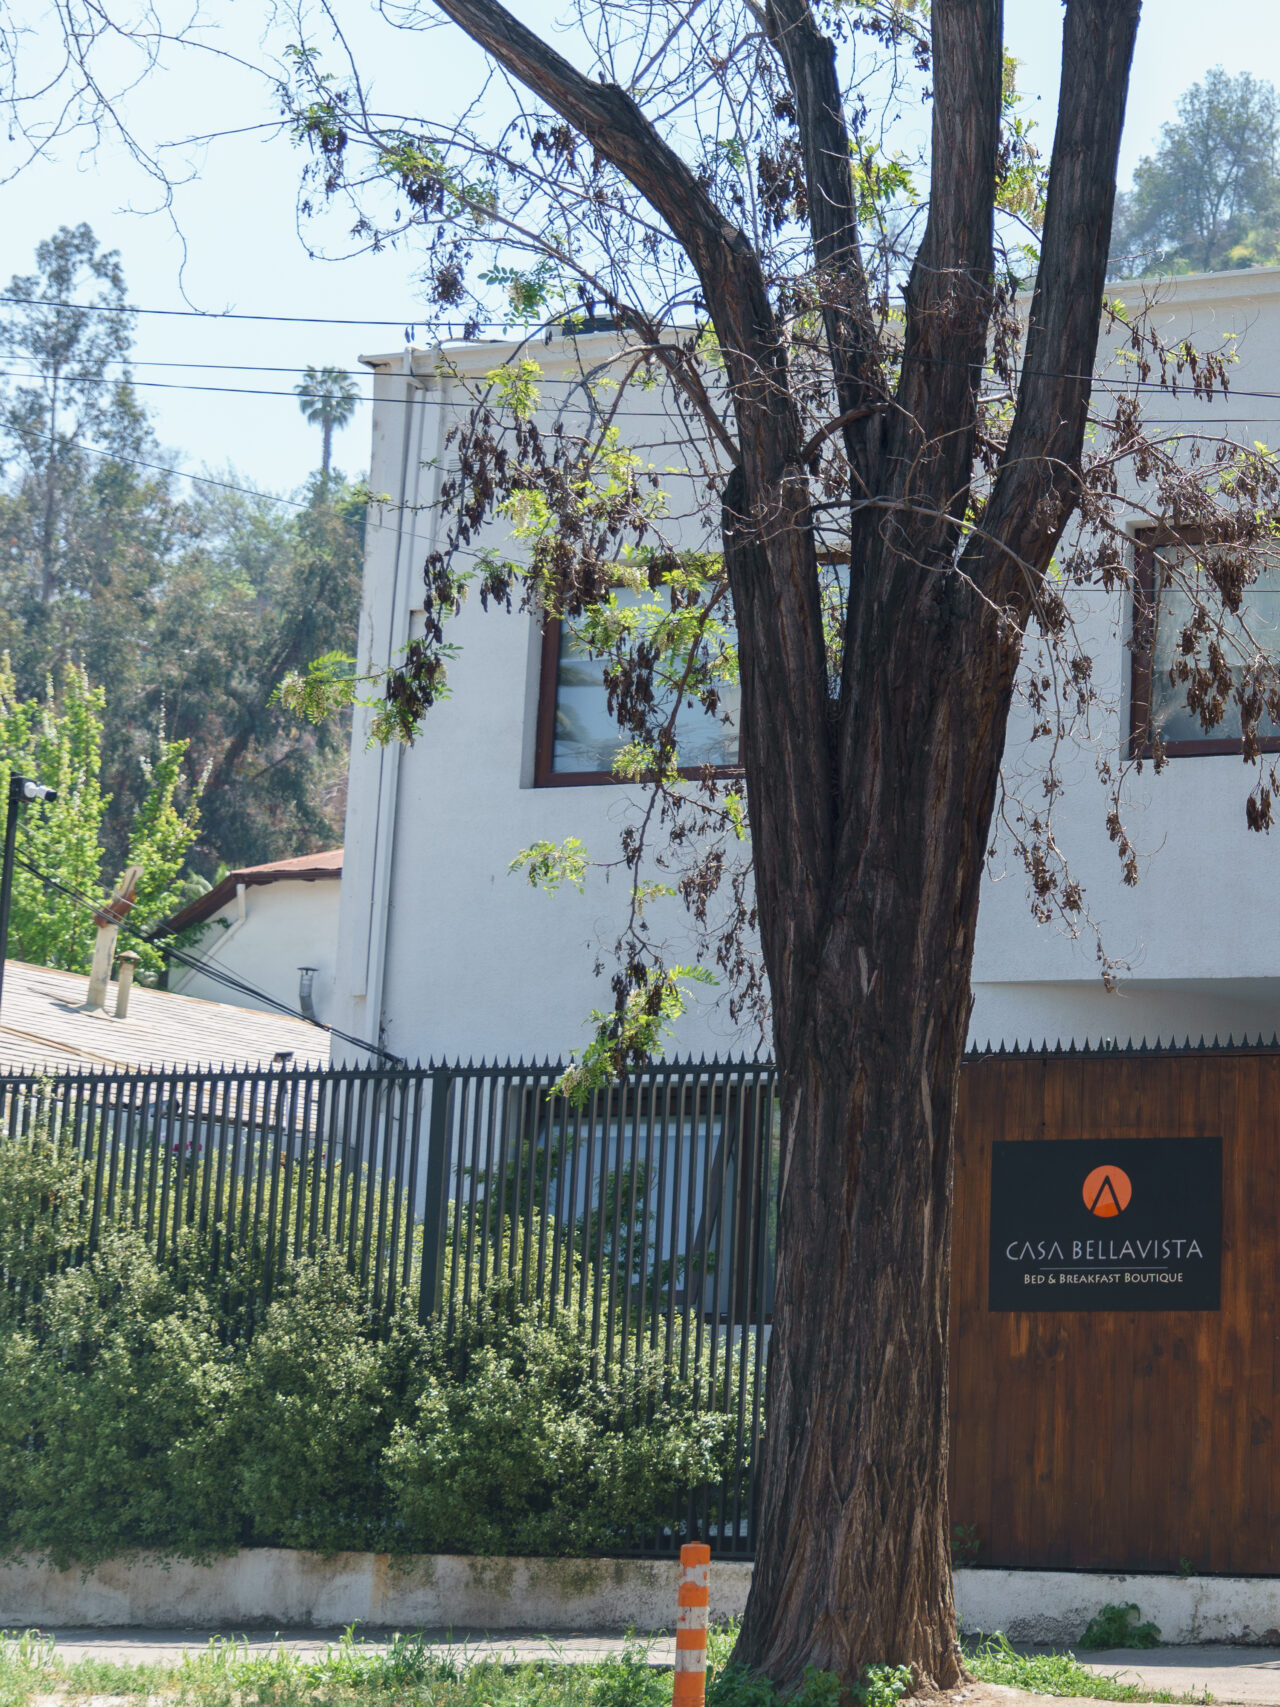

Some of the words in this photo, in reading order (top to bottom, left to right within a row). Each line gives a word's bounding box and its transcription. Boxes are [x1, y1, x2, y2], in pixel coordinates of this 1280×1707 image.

[1006, 1240, 1064, 1261] CASA
[1072, 1239, 1203, 1260] BELLAVISTA
[1024, 1273, 1045, 1285] BED
[1048, 1273, 1057, 1285] &
[1059, 1273, 1121, 1284] BREAKFAST
[1124, 1272, 1184, 1284] BOUTIQUE
